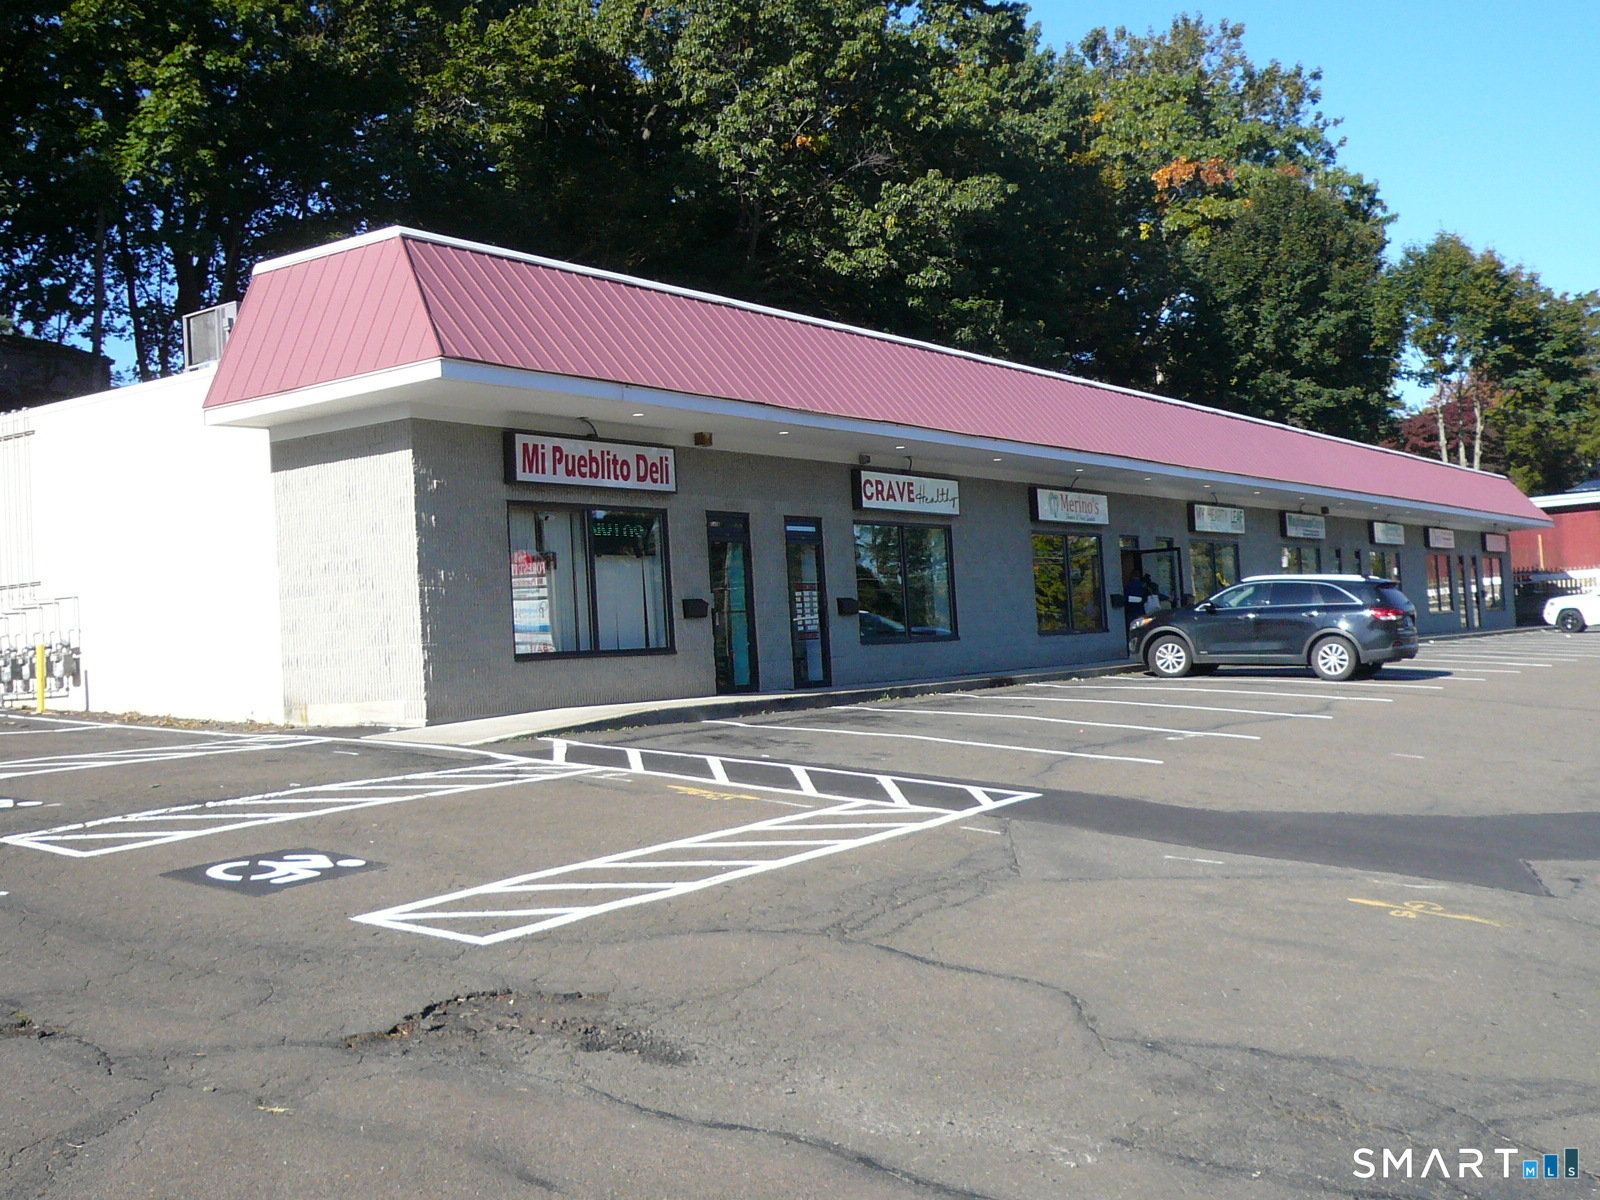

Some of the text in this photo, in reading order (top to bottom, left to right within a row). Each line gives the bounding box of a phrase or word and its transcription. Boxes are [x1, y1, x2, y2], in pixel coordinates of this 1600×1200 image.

[522, 442, 670, 485] Mi Pueblito Deli
[862, 478, 958, 508] CRAVE Healthy
[1060, 493, 1100, 515] Merino's
